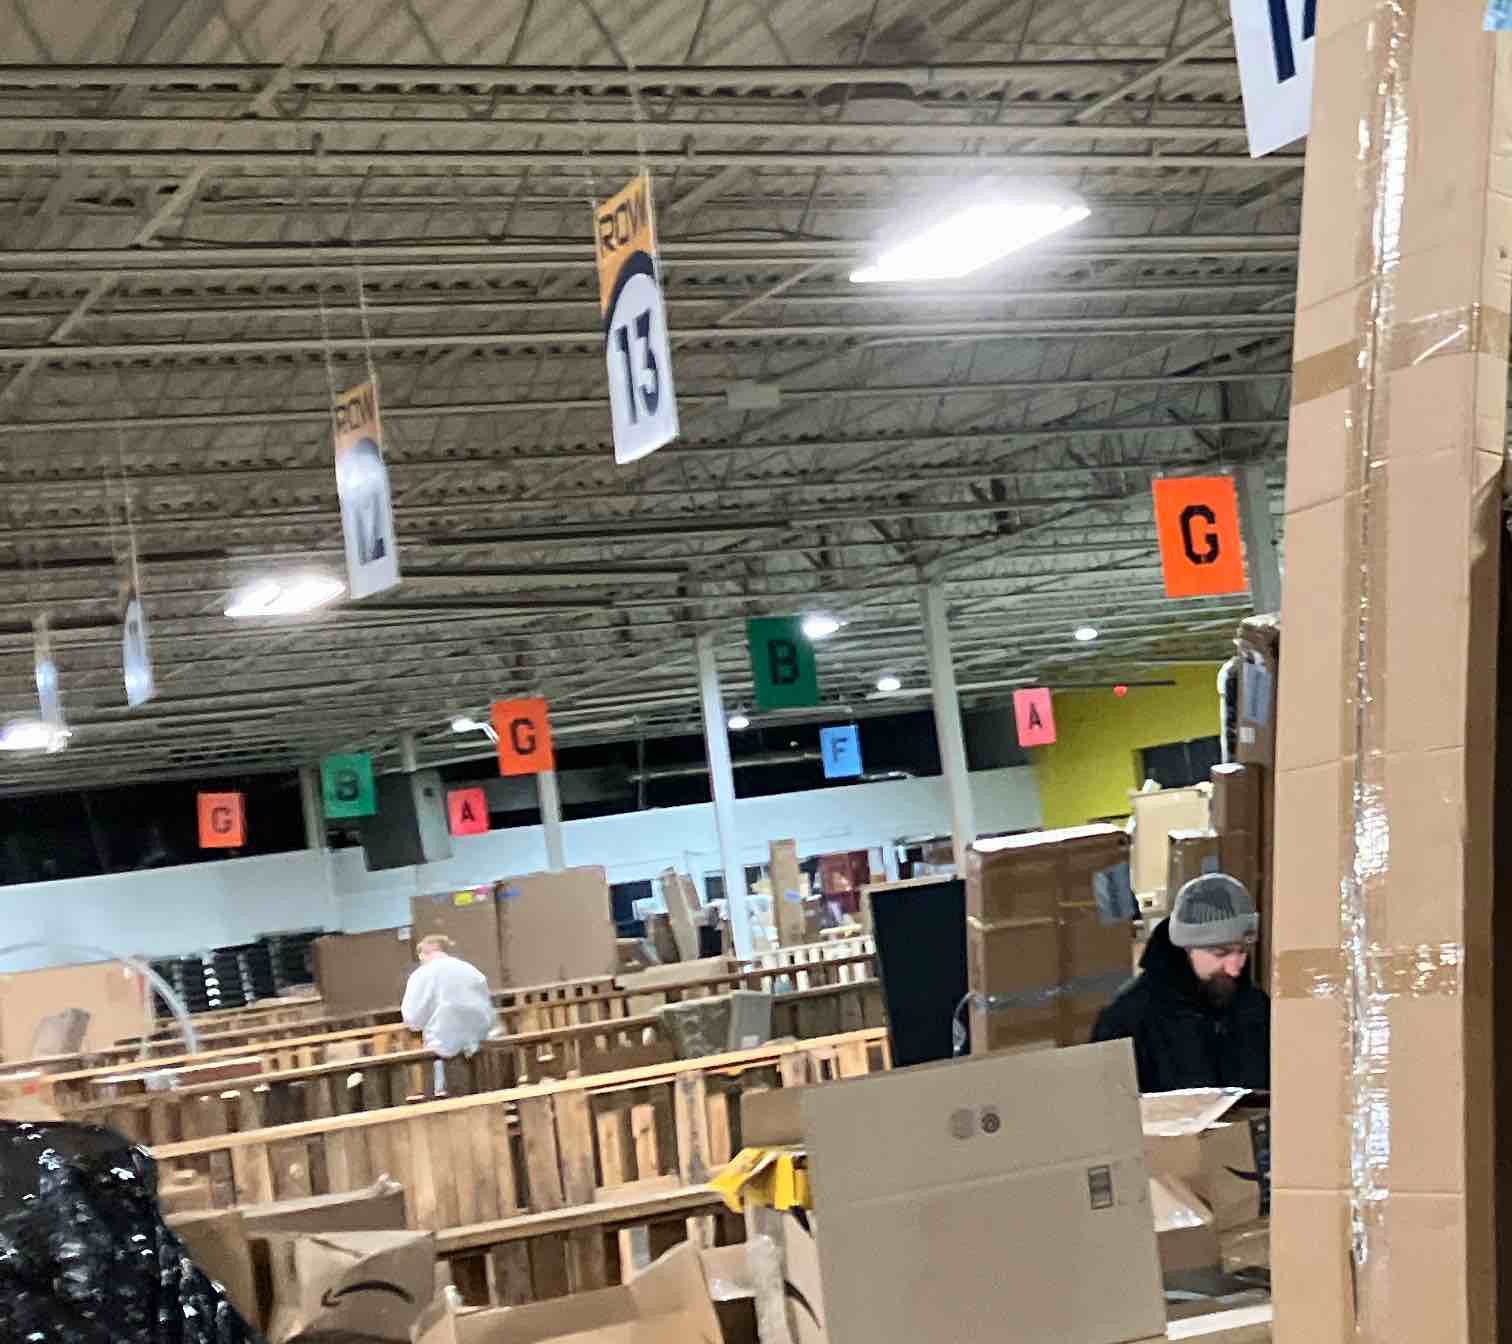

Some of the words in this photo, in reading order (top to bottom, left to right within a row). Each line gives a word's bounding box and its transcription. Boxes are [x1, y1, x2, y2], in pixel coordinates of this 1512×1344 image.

[599, 186, 649, 256] ROW
[615, 309, 660, 426] 13
[335, 387, 375, 435] ROW
[1179, 504, 1220, 565] G
[767, 639, 799, 686] B
[1027, 702, 1045, 731] A
[510, 717, 537, 755] G
[830, 736, 848, 763] F
[334, 768, 361, 802] B
[210, 806, 232, 834] G
[460, 799, 475, 821] A
